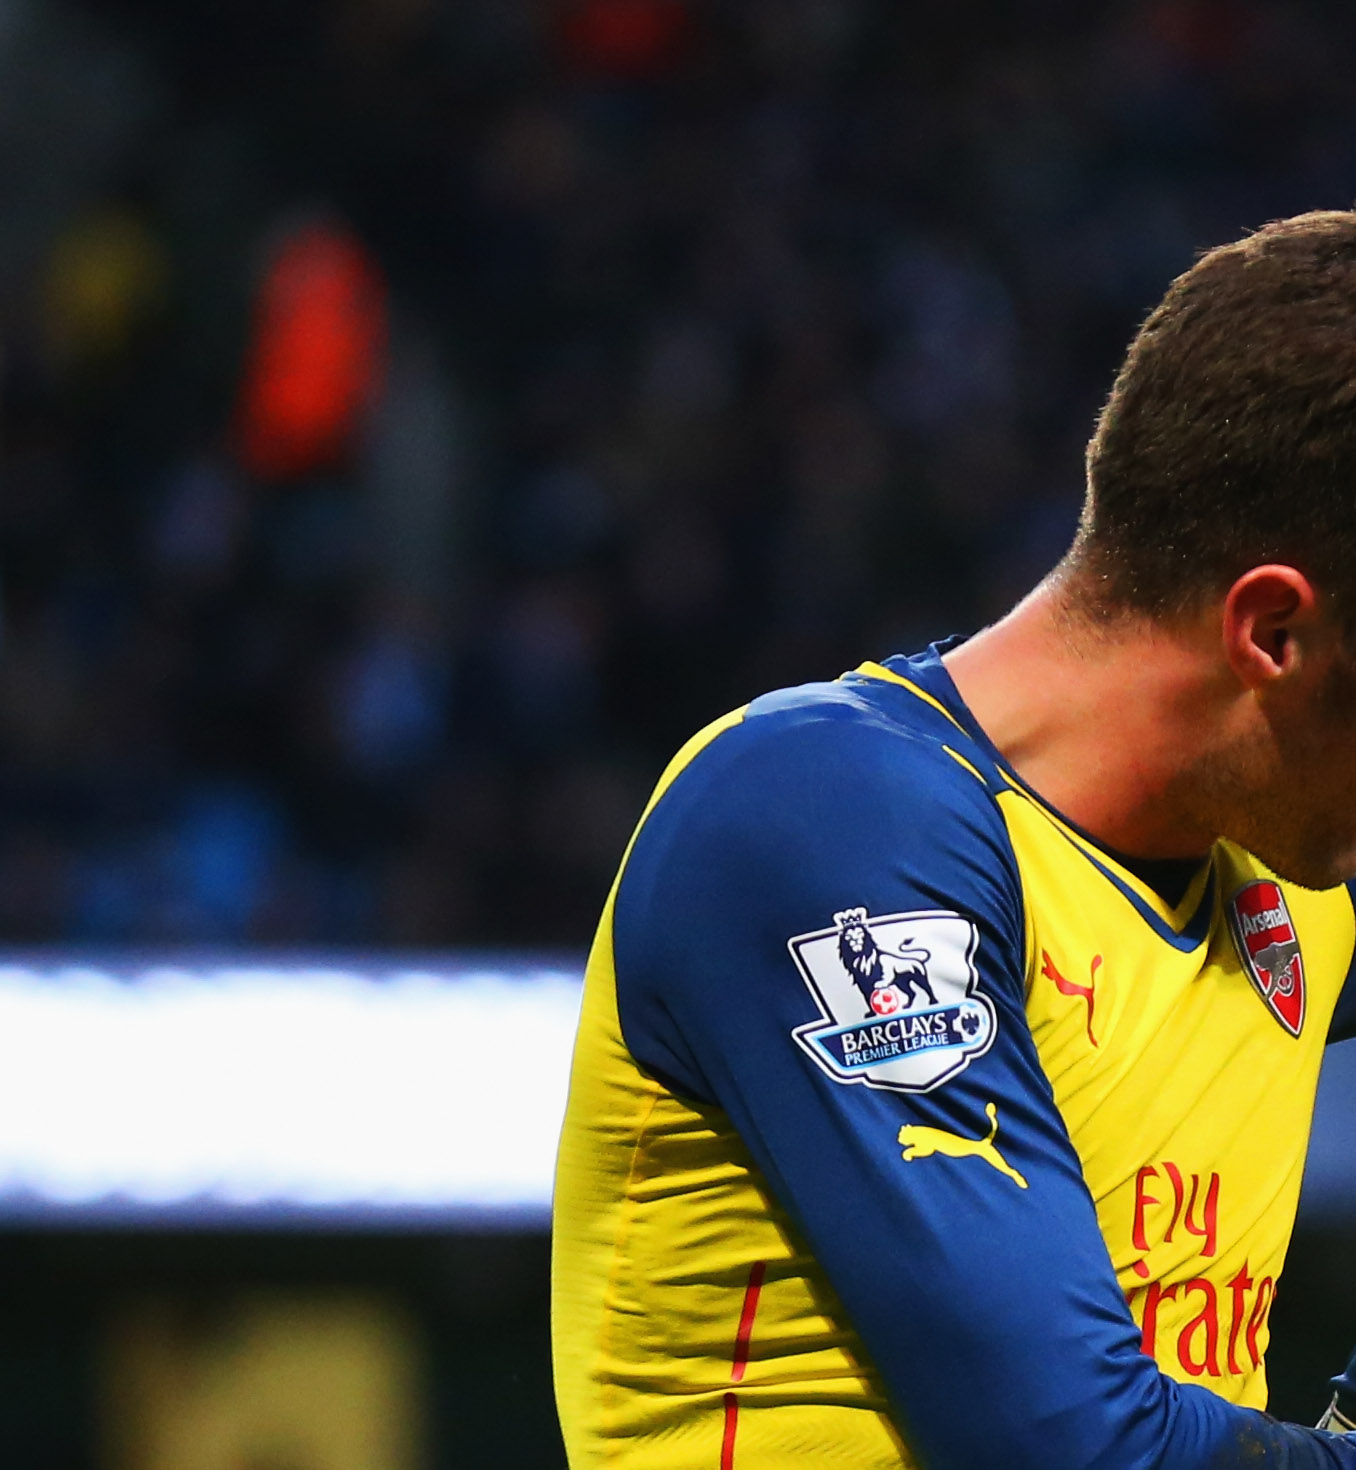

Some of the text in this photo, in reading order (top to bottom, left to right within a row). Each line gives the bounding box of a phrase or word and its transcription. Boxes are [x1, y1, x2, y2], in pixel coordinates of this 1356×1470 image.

[1242, 902, 1288, 936] Arsenal
[841, 1013, 947, 1054] BARCLAYS
[844, 1033, 949, 1067] PREMIER LEAGUE
[1132, 1161, 1220, 1257] Fly
